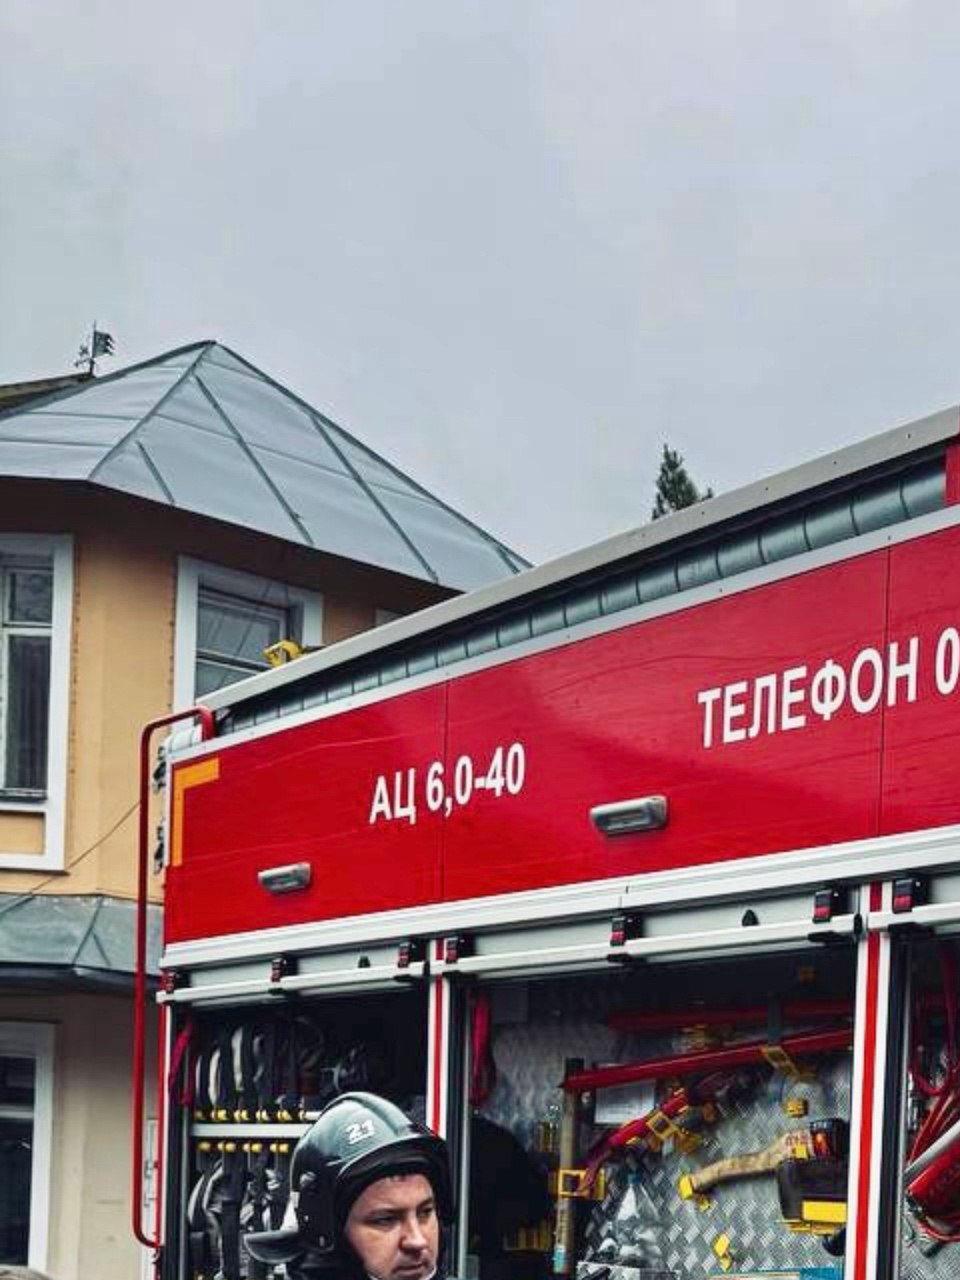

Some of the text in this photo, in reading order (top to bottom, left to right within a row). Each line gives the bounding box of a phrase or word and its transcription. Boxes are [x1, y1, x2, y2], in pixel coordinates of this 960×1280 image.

[698, 637, 919, 748] ТЕЛЕФОН
[369, 742, 525, 825] АЦ 6,0-40
[345, 1119, 375, 1144] 21
